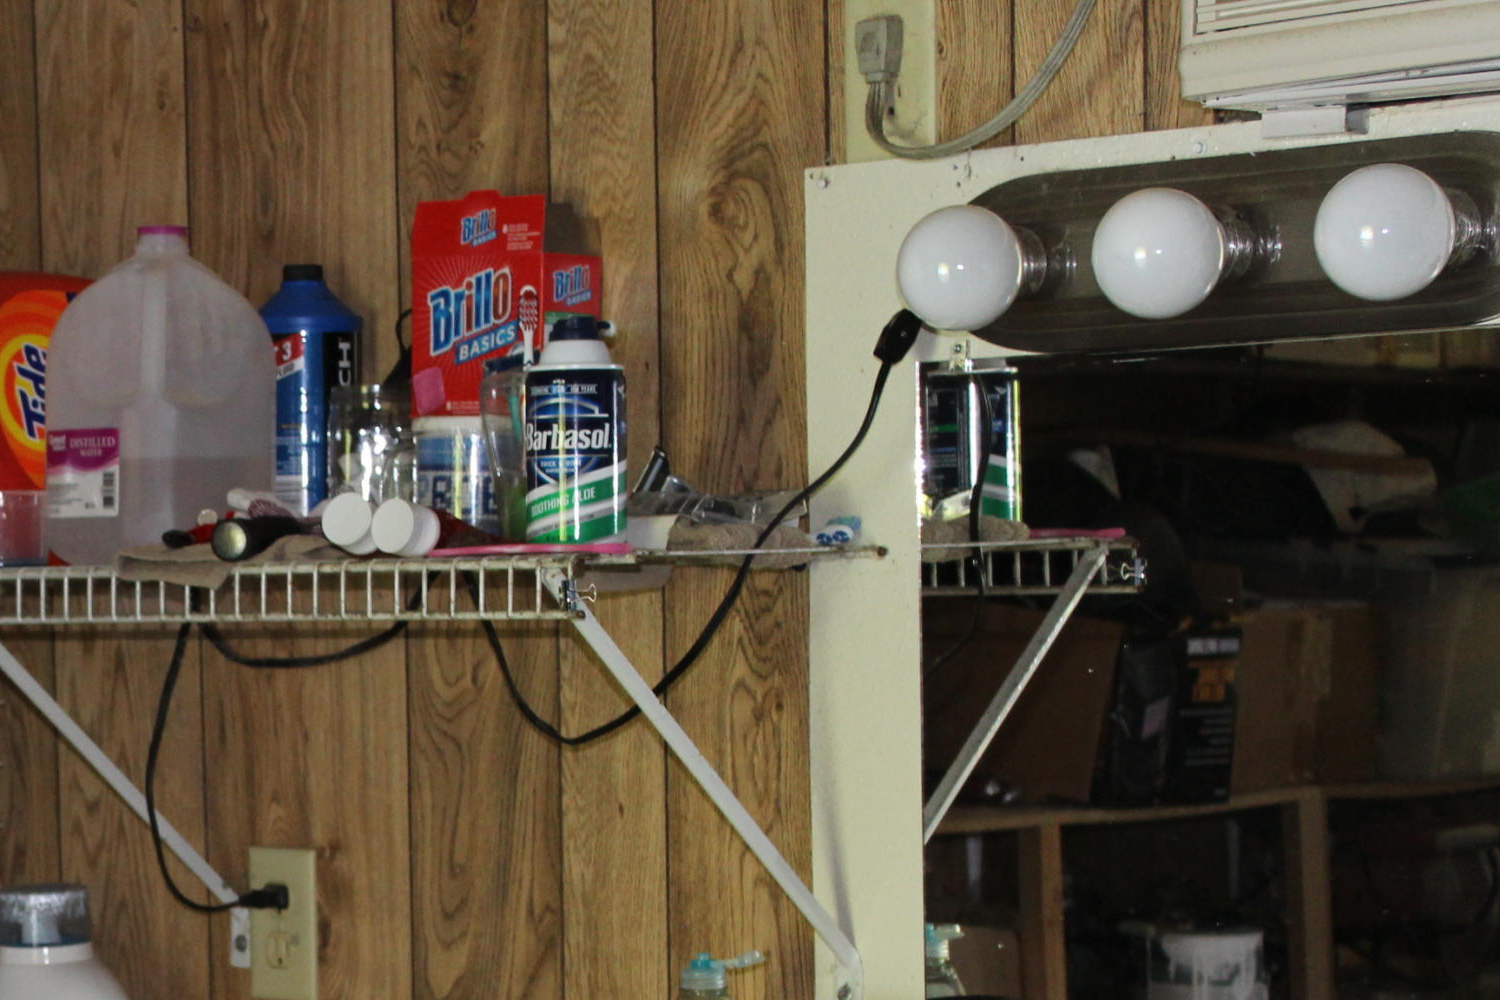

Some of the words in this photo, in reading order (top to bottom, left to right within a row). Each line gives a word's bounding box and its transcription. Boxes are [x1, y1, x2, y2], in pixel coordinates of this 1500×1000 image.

[461, 208, 497, 245] Brillo
[554, 264, 590, 303] Brillo
[428, 267, 513, 357] Brillo
[282, 341, 292, 362] 3
[459, 324, 517, 362] BASICS
[338, 341, 351, 386] CH
[70, 436, 116, 449] DISTILLED
[526, 422, 610, 451] Barbasol
[530, 493, 570, 518] SOOTHING
